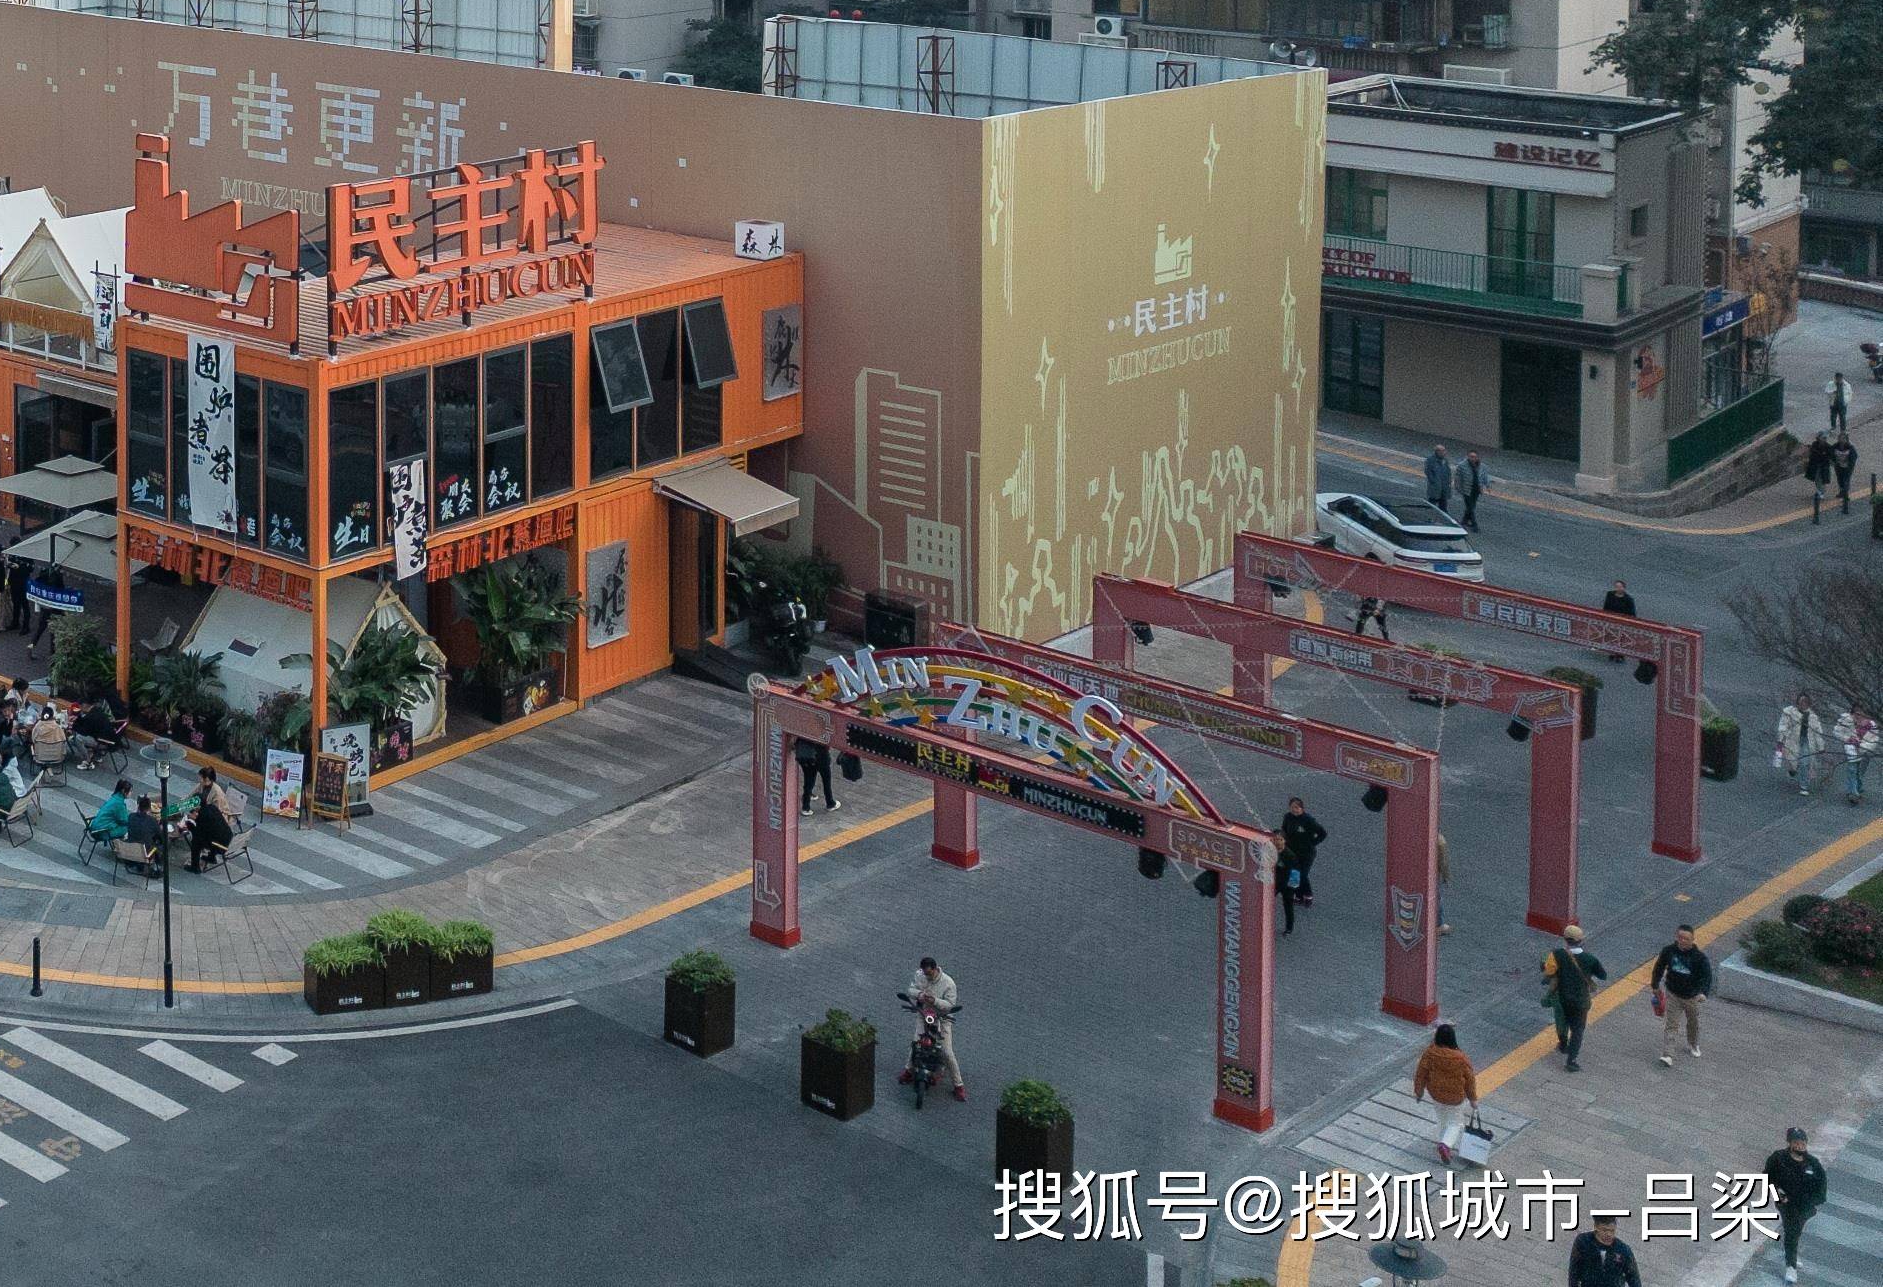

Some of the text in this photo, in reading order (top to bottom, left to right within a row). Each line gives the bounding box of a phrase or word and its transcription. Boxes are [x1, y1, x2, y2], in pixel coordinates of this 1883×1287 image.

[157, 60, 466, 187] 万巷更新
[1493, 142, 1601, 168] 建设记忆
[327, 140, 607, 293] 民主村
[329, 248, 599, 342] MINZHUCUN
[1135, 284, 1209, 338] 民主村
[1107, 326, 1232, 385] MINZHUCUN
[188, 342, 234, 485] 围炉煮茶
[487, 482, 521, 509] 会议
[334, 516, 369, 552] 生日
[1478, 600, 1572, 637] 居民新家园
[917, 741, 973, 773] 民主村
[1177, 830, 1234, 857] SPACE
